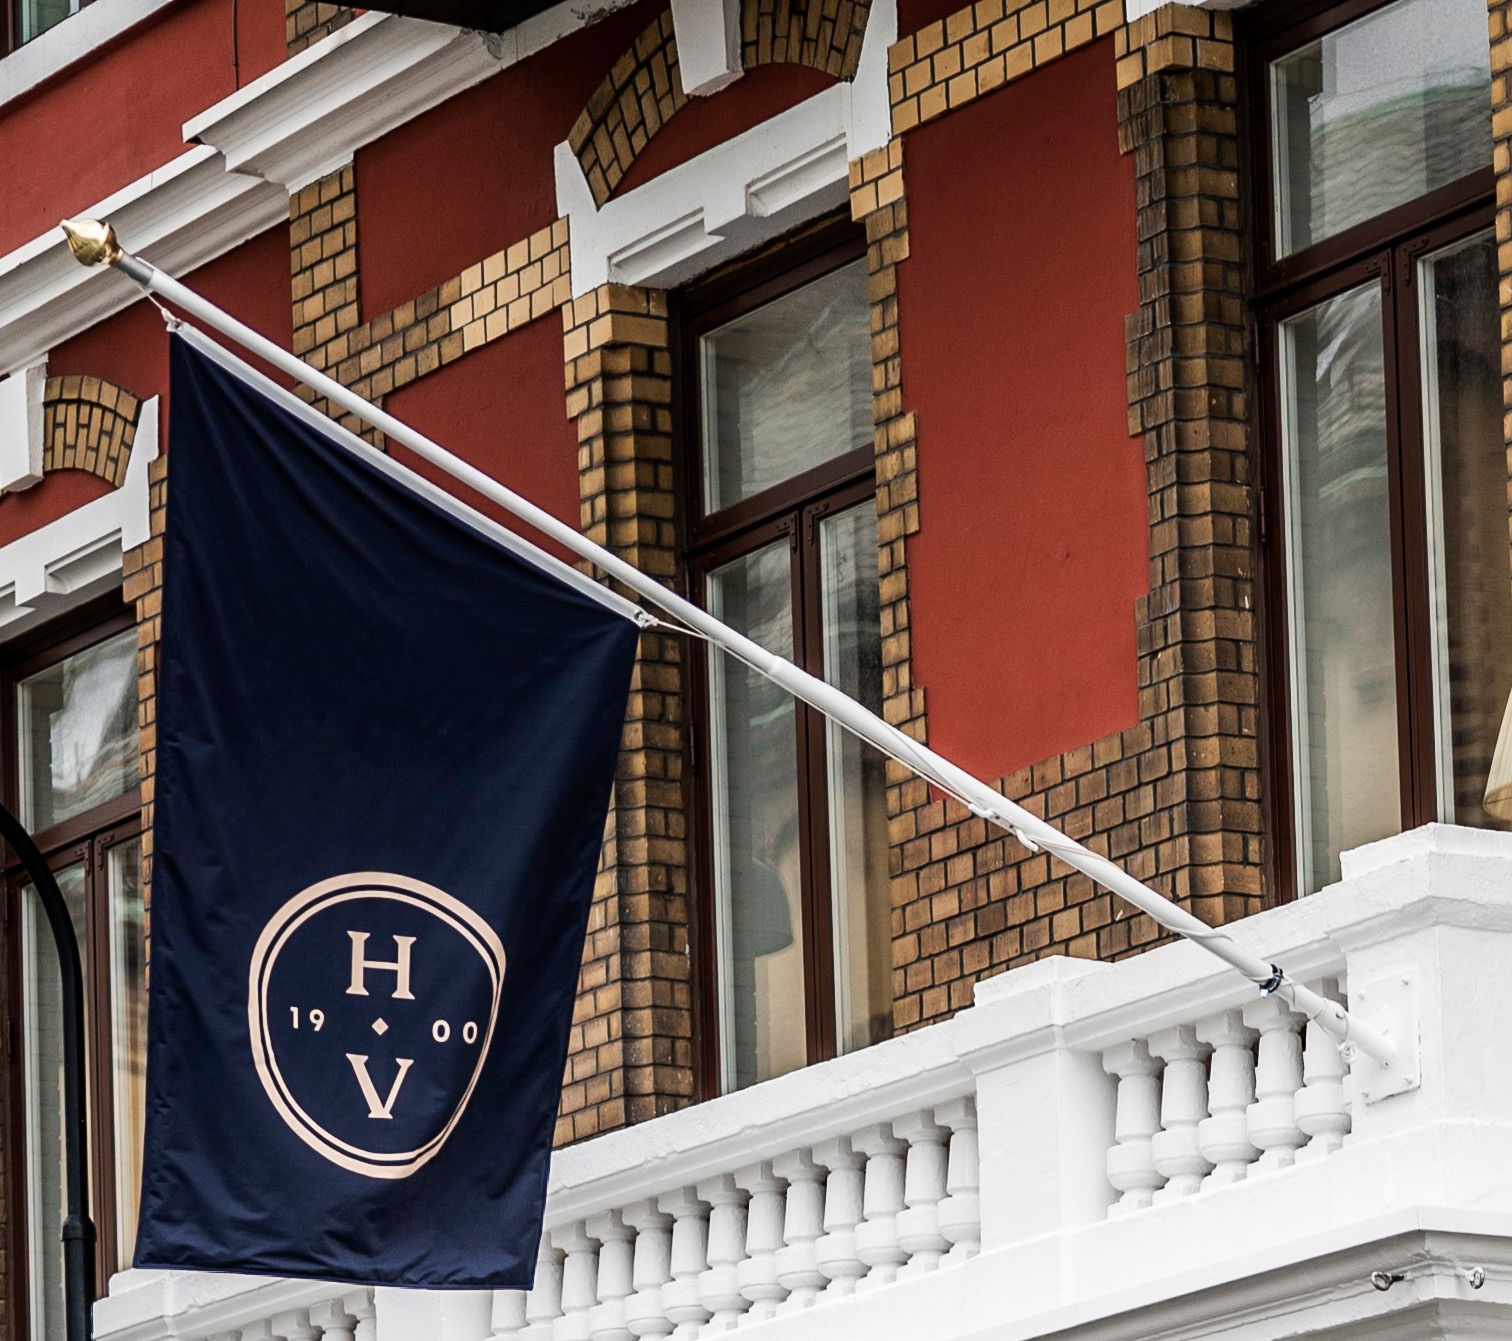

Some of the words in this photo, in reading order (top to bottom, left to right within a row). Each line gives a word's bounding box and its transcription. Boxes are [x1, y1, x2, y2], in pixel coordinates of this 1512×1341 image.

[346, 930, 417, 1000] H
[289, 1006, 325, 1032] 19
[431, 1019, 478, 1044] 00
[346, 1053, 414, 1119] V
